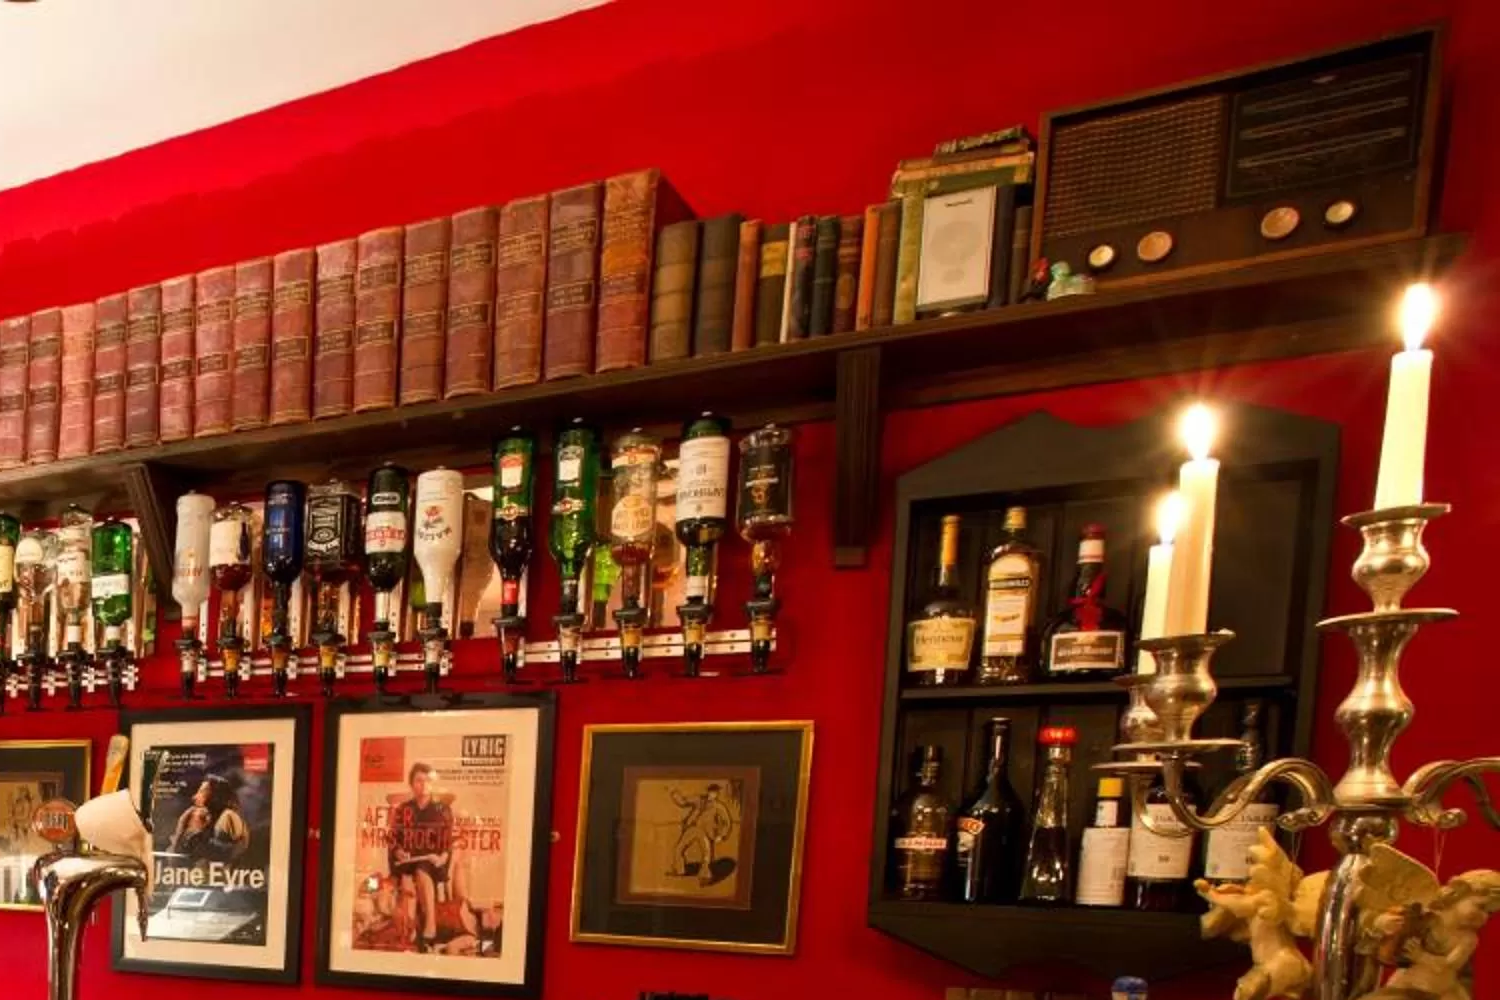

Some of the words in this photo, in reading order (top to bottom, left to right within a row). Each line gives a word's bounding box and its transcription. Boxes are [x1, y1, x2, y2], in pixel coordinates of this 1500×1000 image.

[464, 737, 504, 756] LYRIC
[361, 826, 397, 849] MRS
[155, 860, 204, 887] Jane
[209, 862, 265, 893] Eyre
